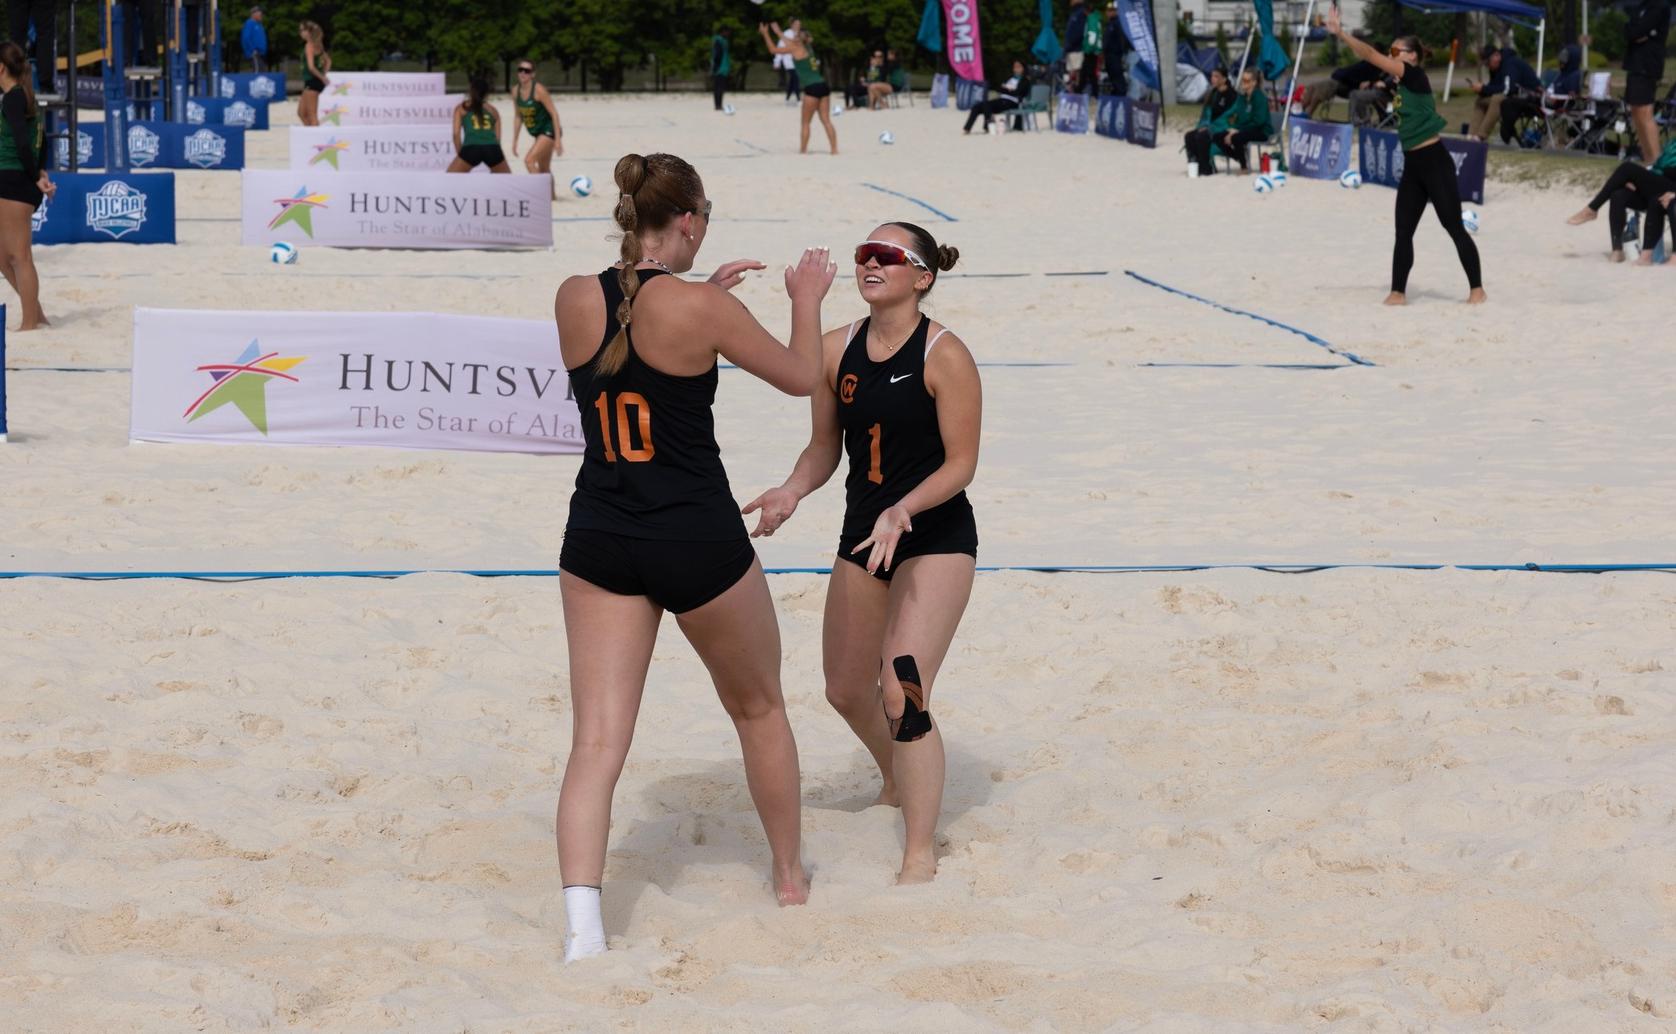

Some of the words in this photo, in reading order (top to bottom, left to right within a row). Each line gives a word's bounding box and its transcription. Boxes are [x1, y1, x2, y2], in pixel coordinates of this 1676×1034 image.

[92, 195, 140, 219] NJCAA
[350, 192, 531, 218] HUNTSVILLE
[357, 220, 387, 235] The
[393, 221, 425, 236] Star
[432, 221, 450, 236] of
[453, 223, 523, 239] Alabama
[350, 406, 406, 429] The
[412, 407, 478, 433] Star
[488, 411, 519, 435] of
[594, 391, 656, 462] 10
[867, 422, 884, 486] 1
